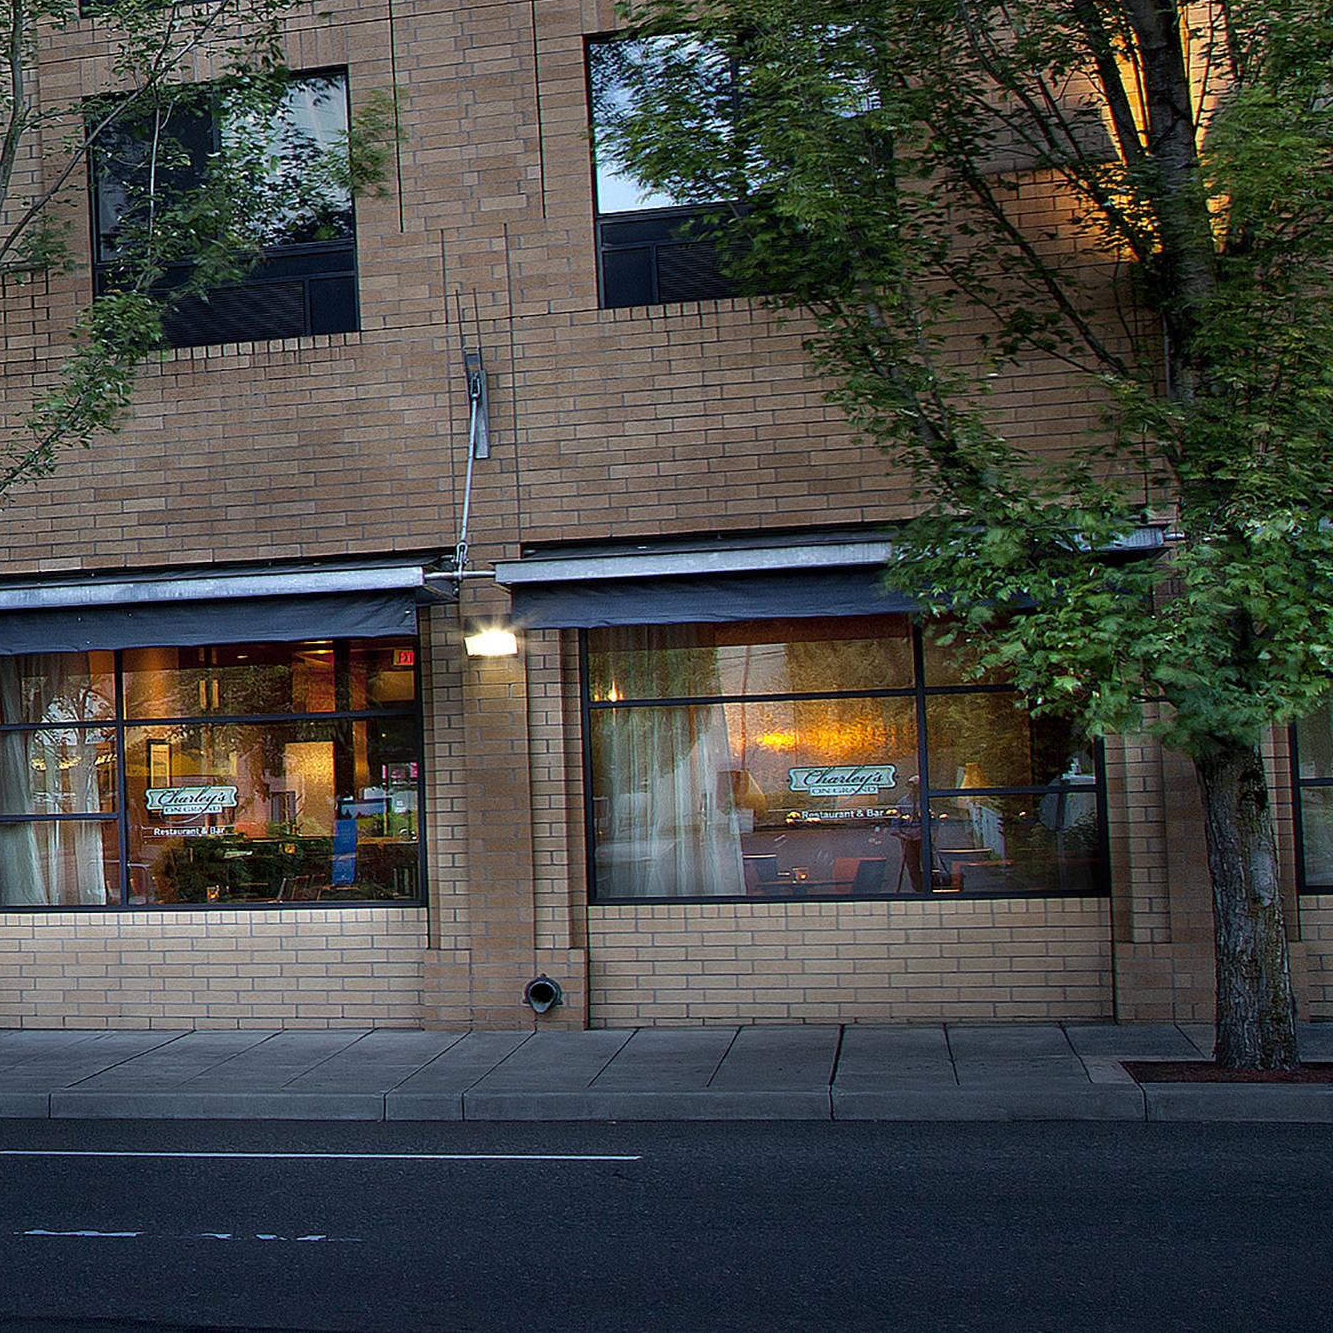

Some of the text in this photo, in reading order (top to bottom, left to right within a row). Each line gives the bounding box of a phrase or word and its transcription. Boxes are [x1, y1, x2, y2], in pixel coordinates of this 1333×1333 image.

[802, 808, 885, 819] Restaurant & Bar
[153, 827, 200, 836] Restaurant
[210, 826, 225, 835] Bar
